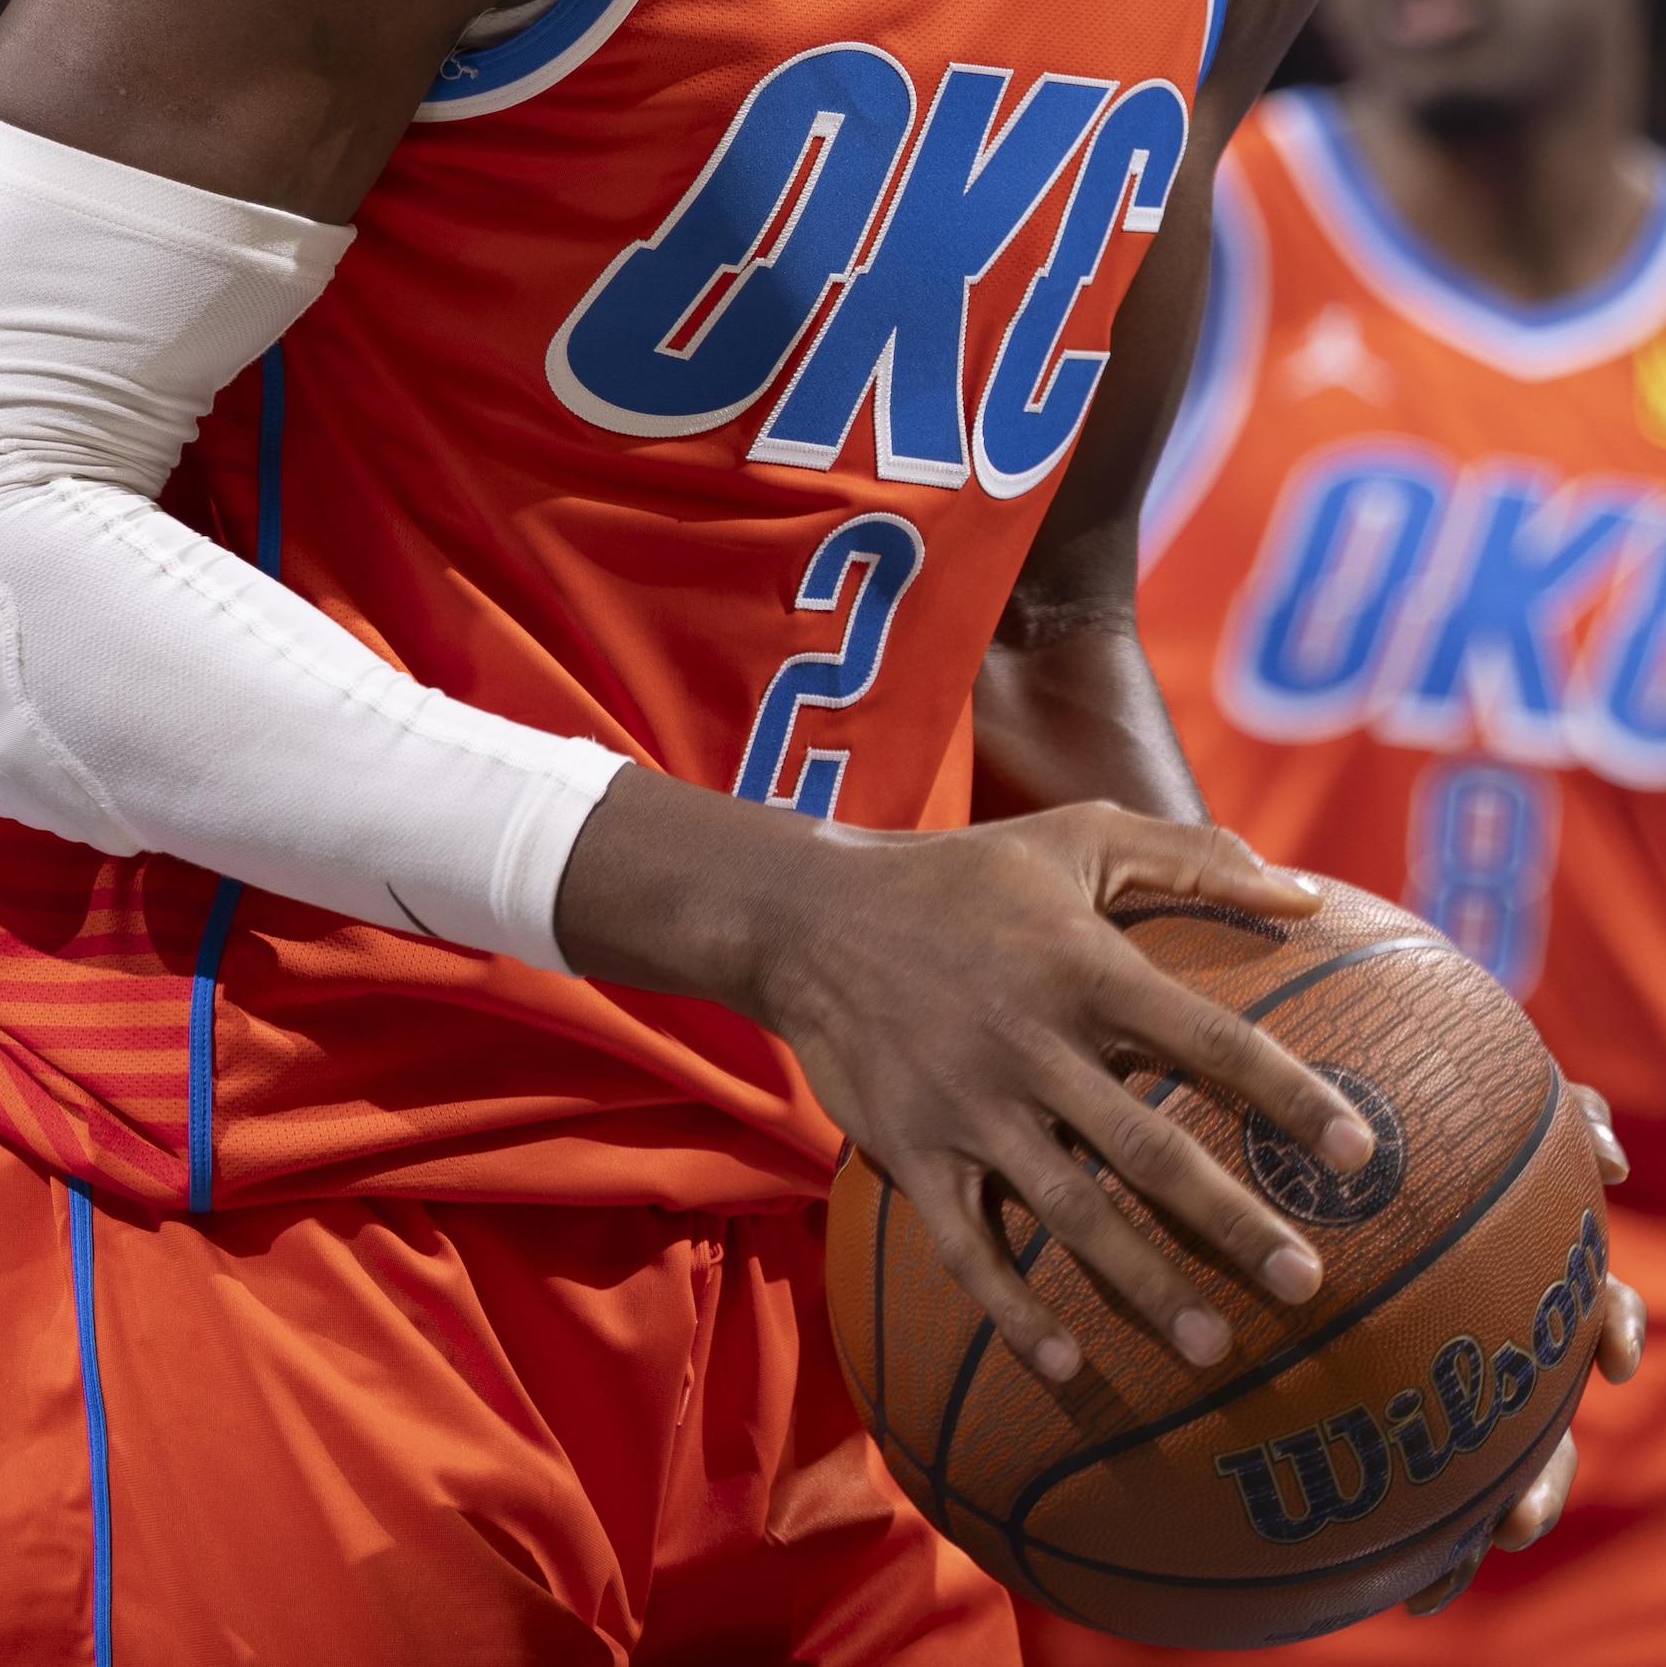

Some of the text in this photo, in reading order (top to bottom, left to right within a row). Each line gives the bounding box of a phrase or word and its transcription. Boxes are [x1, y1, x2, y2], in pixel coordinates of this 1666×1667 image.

[545, 41, 1190, 500] OKC
[733, 512, 925, 822] 2
[1407, 758, 1561, 1002] 8
[1212, 1207, 1607, 1544] Wilson
